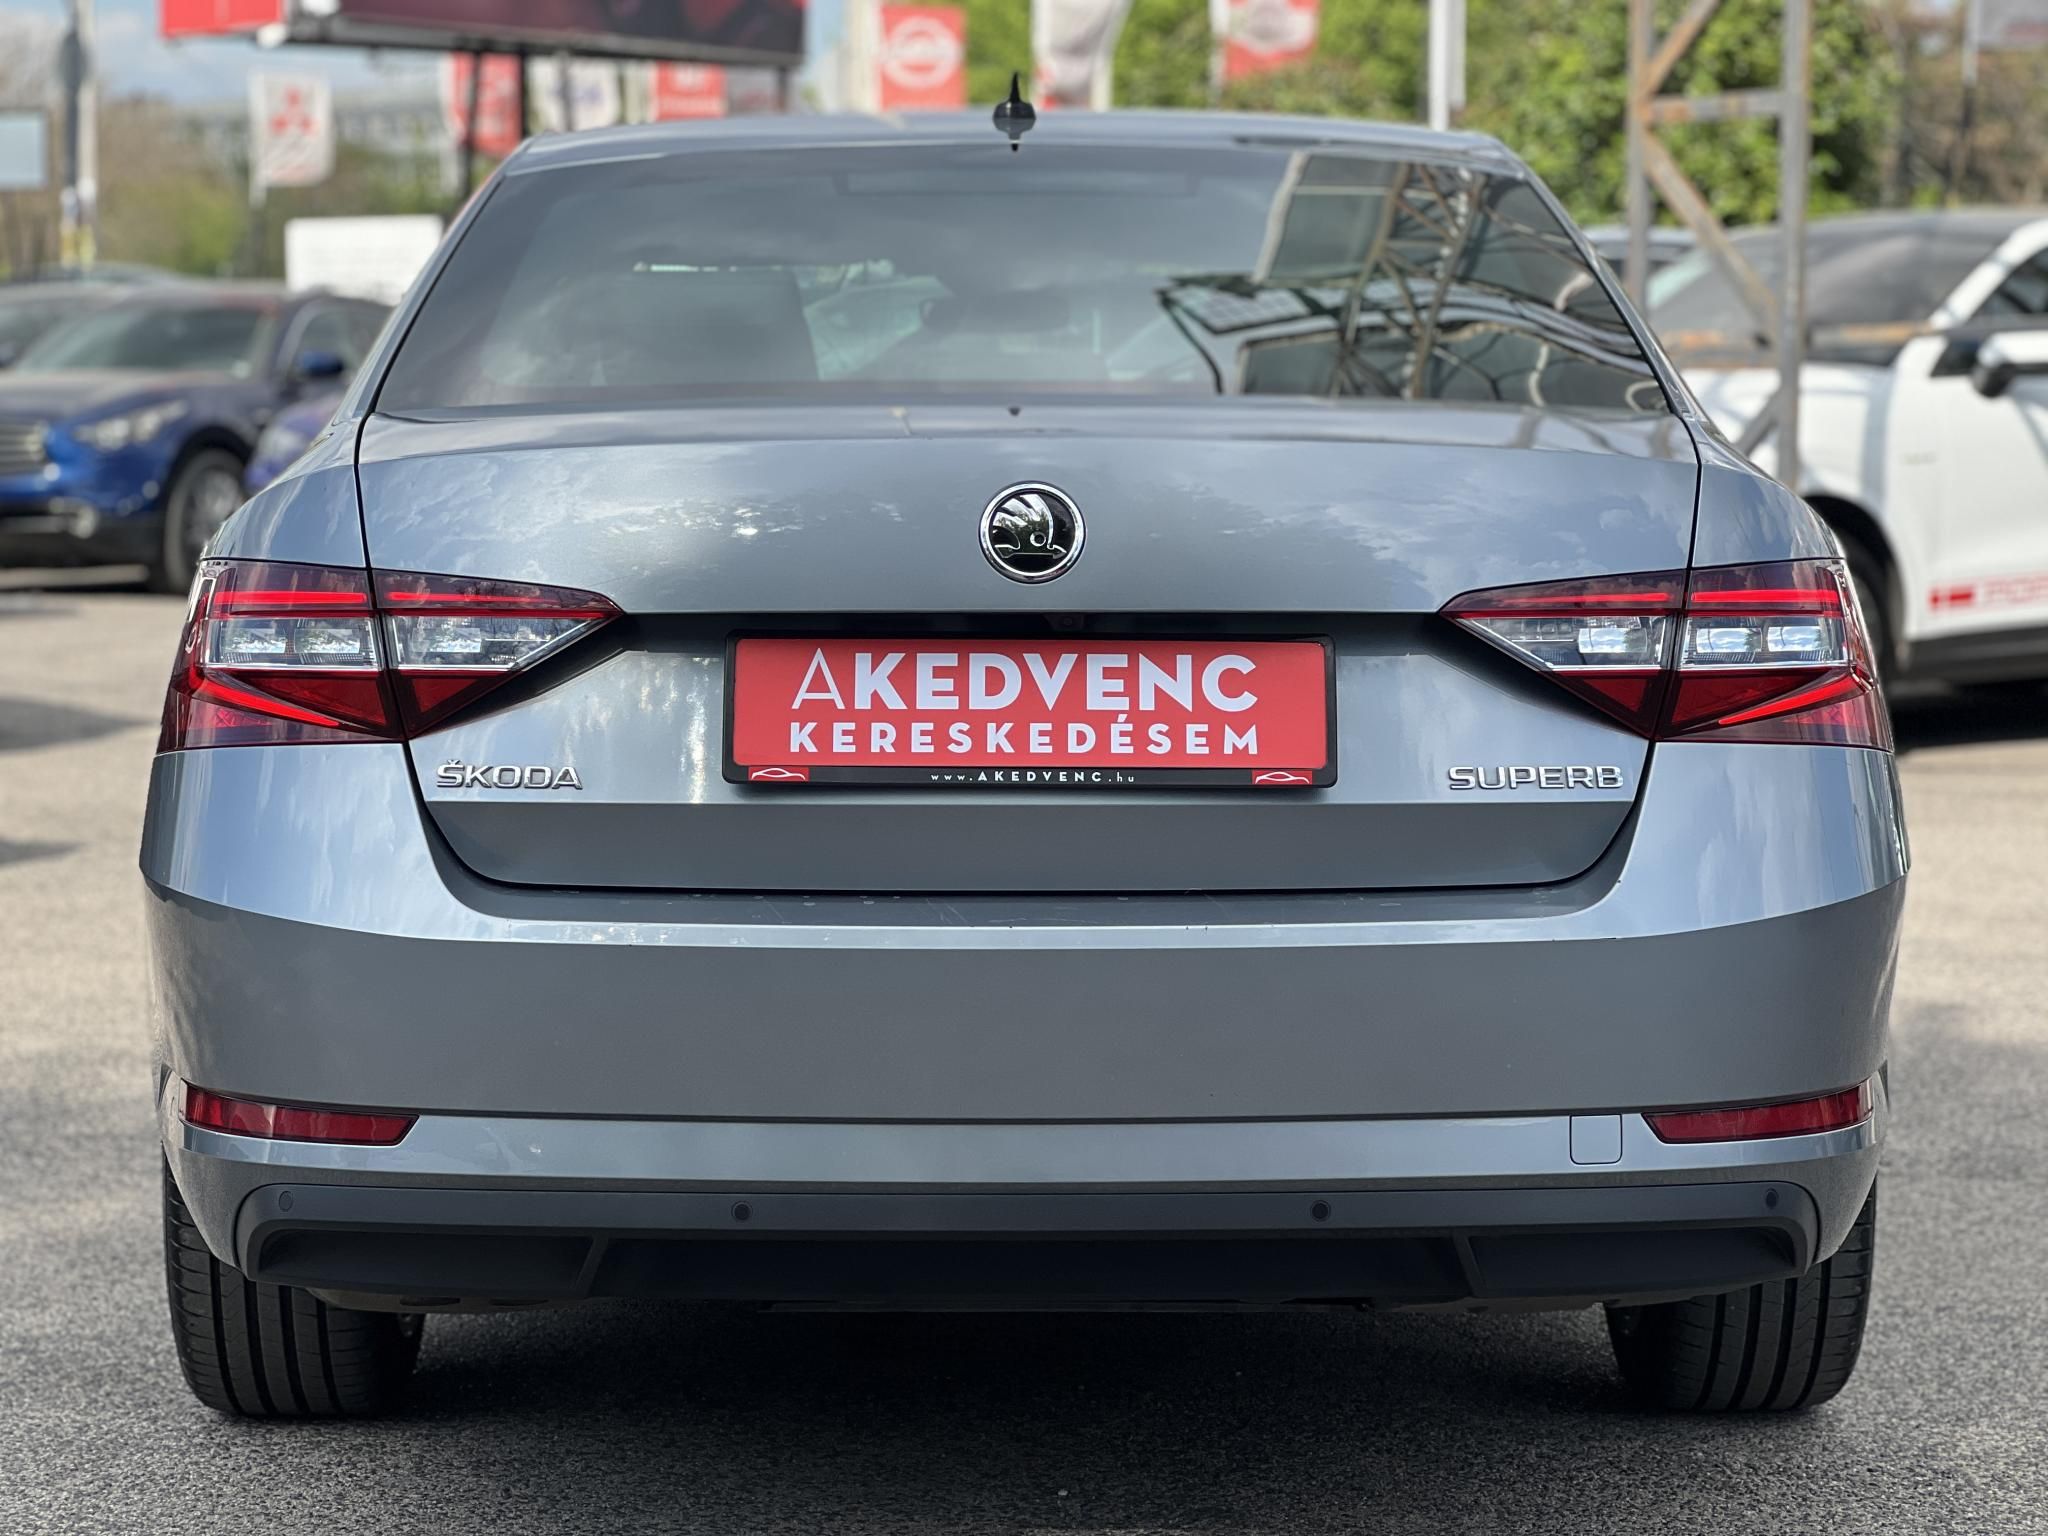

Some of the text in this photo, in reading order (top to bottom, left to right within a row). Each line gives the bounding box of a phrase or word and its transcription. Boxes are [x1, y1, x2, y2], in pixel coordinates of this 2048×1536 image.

[789, 714, 1258, 755] KERESKEDÉSEM
[436, 760, 583, 790] ŠKODA
[930, 771, 1136, 783] www.AKEDVENC.hu
[1448, 765, 1625, 790] SUPERB
